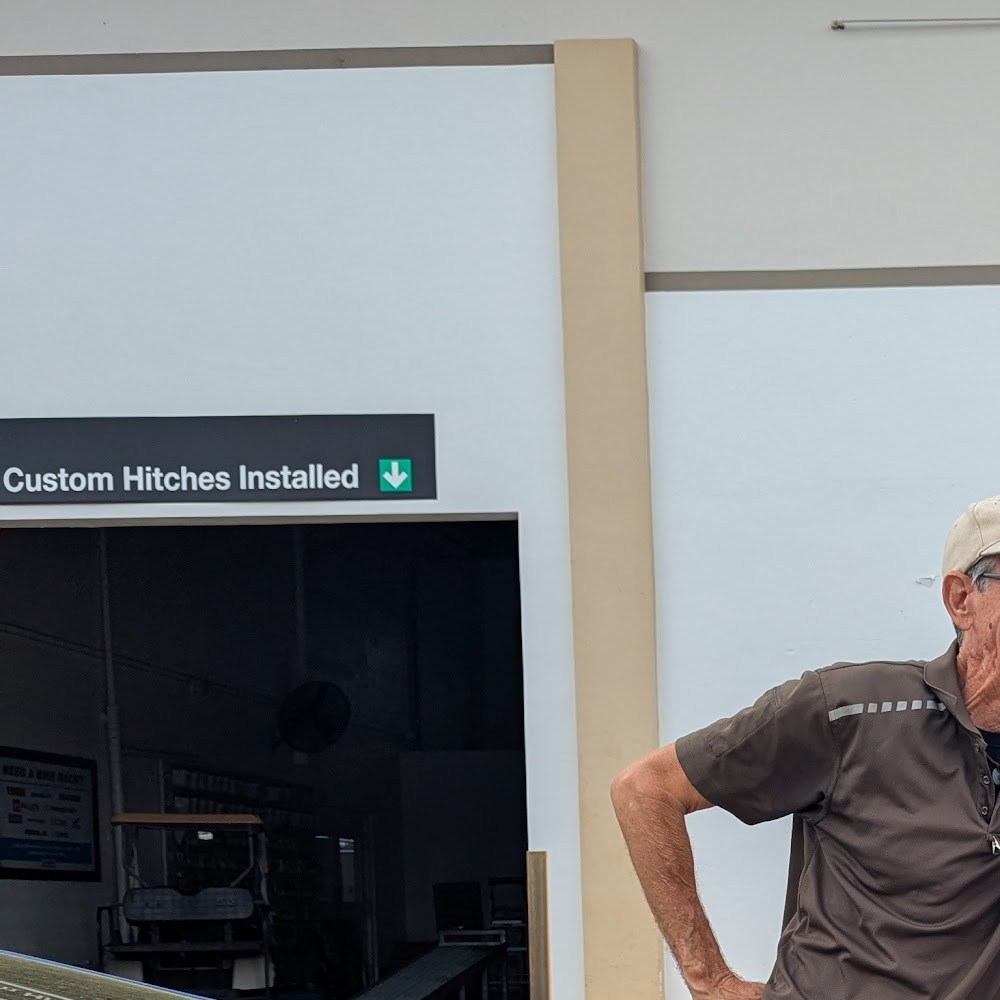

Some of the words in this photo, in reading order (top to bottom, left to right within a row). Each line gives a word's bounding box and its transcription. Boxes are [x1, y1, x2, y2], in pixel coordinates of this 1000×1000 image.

[3, 467, 114, 492] Custom
[123, 465, 231, 491] Hitches
[240, 463, 359, 490] Installed
